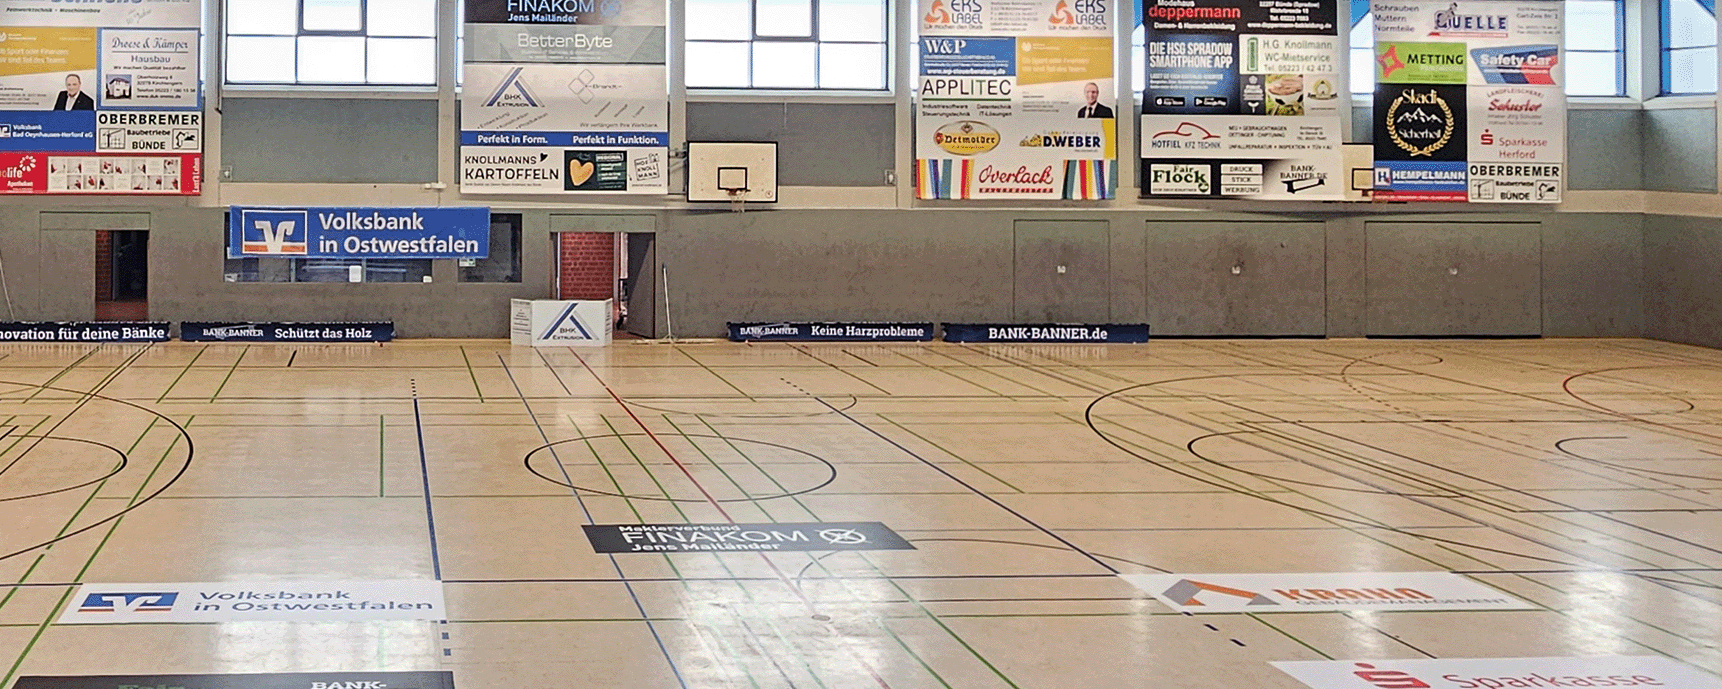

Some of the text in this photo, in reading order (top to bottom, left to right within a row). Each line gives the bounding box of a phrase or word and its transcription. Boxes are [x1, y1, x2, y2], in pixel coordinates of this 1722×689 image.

[507, 0, 594, 12] FINAKOM
[1149, 5, 1240, 20] deppermann
[508, 14, 578, 22] Jens Mailänder
[518, 33, 613, 50] BetterByte
[1285, 40, 1332, 49] Knollmann
[925, 40, 966, 54] W&P
[1150, 43, 1232, 57] DIE HSG SPRADOW
[131, 55, 171, 63] Hausbau
[1150, 56, 1233, 68] SMARTPHONE APP
[1265, 53, 1330, 62] WC-Mietservice
[1407, 54, 1463, 64] METTING
[1481, 54, 1551, 67] Safety Car
[922, 79, 1011, 95] APPLITEC
[99, 114, 199, 125] OBERBREMER
[478, 135, 548, 144] Perfekt in Form.
[573, 136, 659, 144] Perfekt in Funktion.
[945, 135, 995, 143] Detmolder
[1043, 136, 1100, 147] D.WEBER
[1500, 138, 1547, 147] Sparkasse
[132, 141, 165, 149] BÜNDE
[1152, 141, 1181, 149] HOTFIEL
[1500, 150, 1535, 158] Herford
[465, 156, 537, 164] KNOLLMANNS
[465, 169, 559, 179] KARTOFFELN
[979, 165, 1053, 184] Overlack
[1393, 171, 1465, 179] HEMPELMANN
[1471, 166, 1559, 176] OBERBREMER
[1153, 170, 1207, 183] Flock
[1501, 192, 1530, 200] BÜNDE
[319, 213, 424, 230] Volksbank
[319, 235, 478, 253] in Ostwestfalen
[58, 328, 78, 340] für
[82, 328, 118, 340] deine
[122, 328, 164, 339] Bänke
[275, 329, 319, 338] Schützt
[322, 329, 342, 338] das
[345, 328, 372, 338] Holz
[811, 326, 843, 335] Keine
[846, 326, 924, 338] Harzprobleme
[989, 328, 1107, 339] BANK-BANNER.de
[622, 531, 809, 543] FINAKOM
[632, 542, 781, 551] Jens Mailänder
[199, 591, 350, 601] Volksbank
[194, 601, 433, 611] in Ostwestfalen
[1442, 673, 1664, 689] Sparkasse
